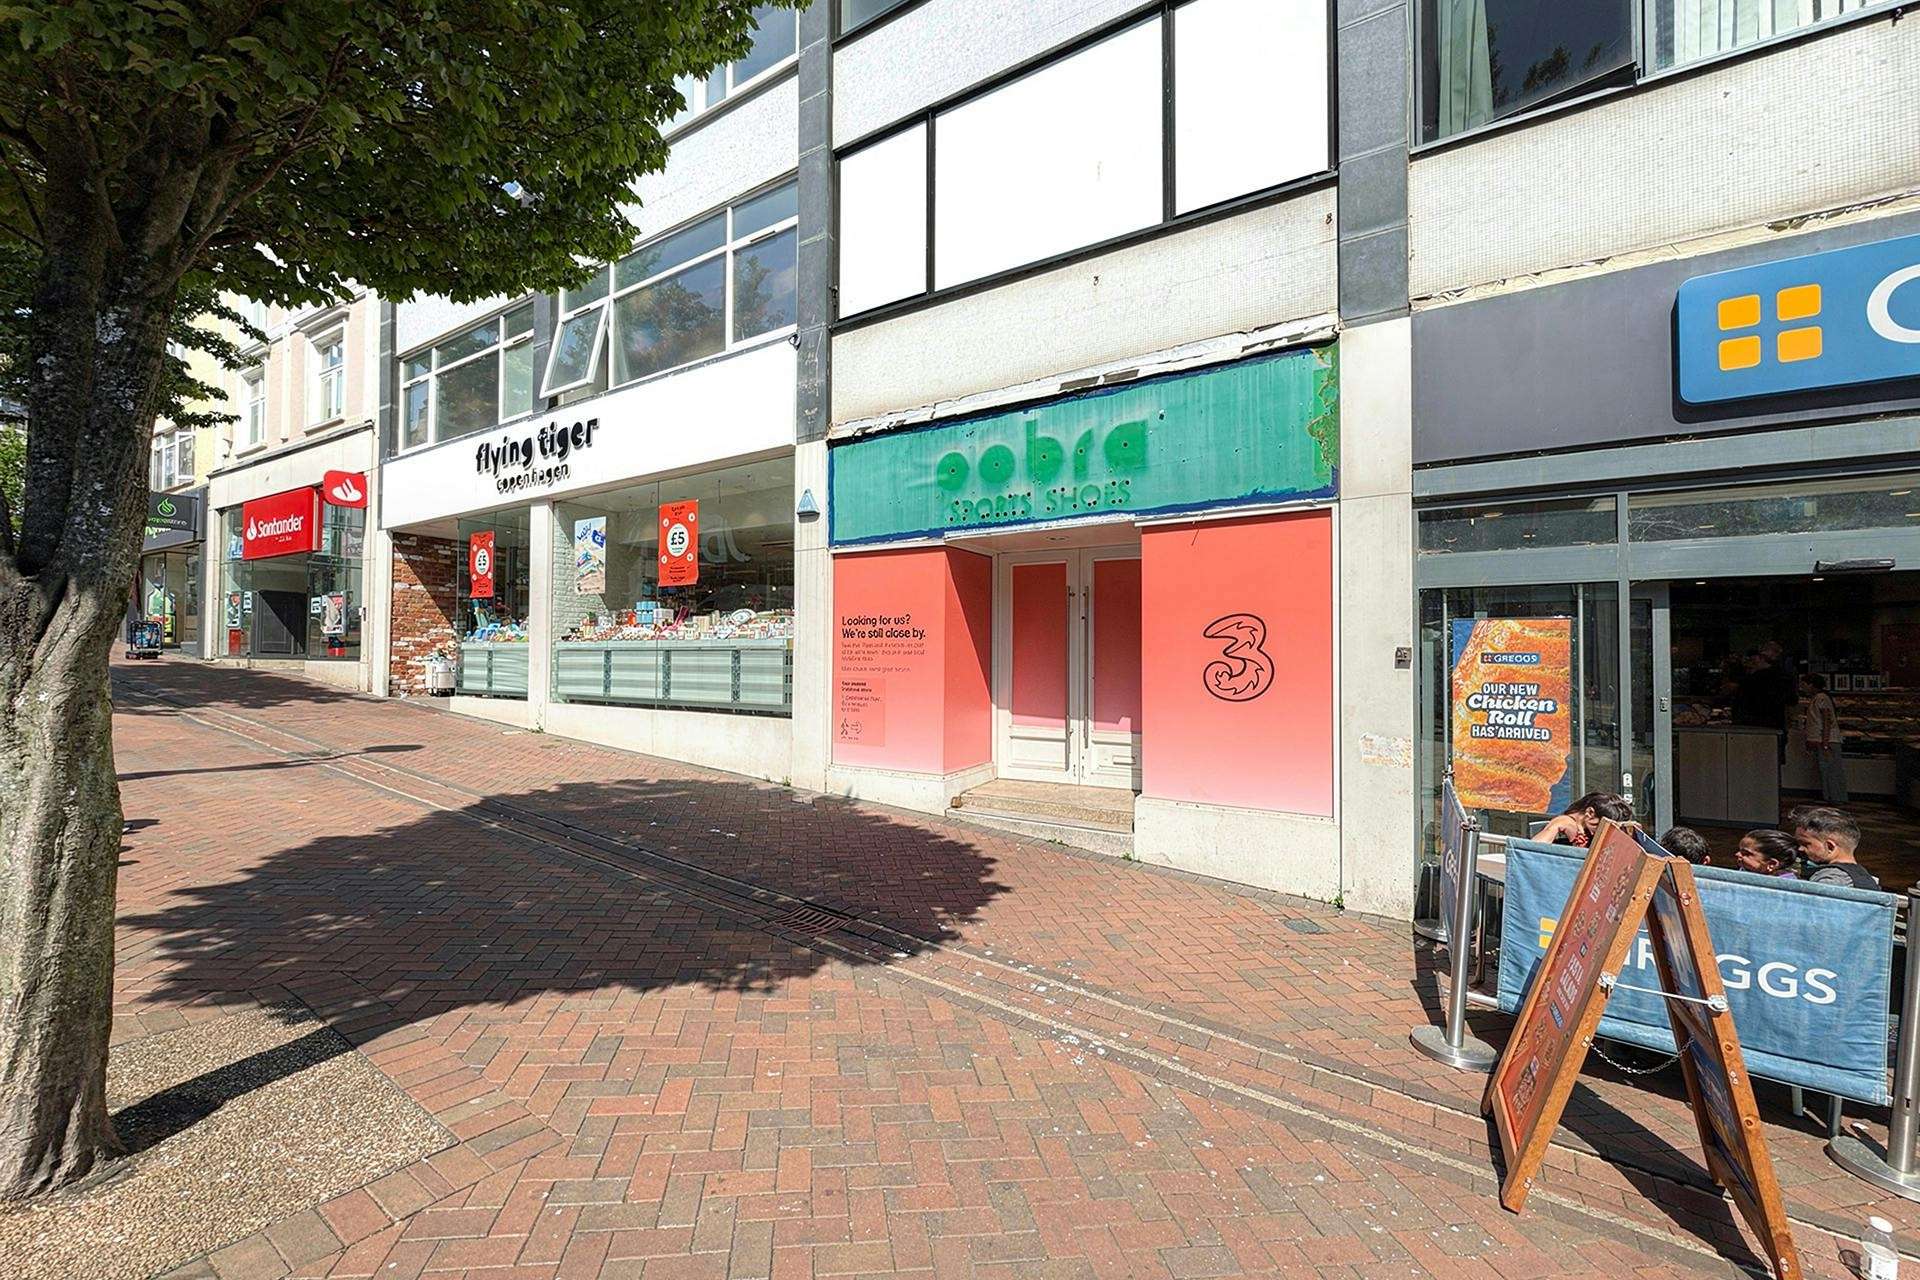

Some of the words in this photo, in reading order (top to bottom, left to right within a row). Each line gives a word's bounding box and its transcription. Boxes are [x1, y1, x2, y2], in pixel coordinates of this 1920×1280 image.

[476, 436, 534, 478] flying
[537, 418, 600, 460] tiger
[496, 463, 571, 494] copenhagen
[949, 493, 1032, 523] SPORTS
[257, 513, 304, 538] Santander
[670, 531, 685, 546] £5
[478, 554, 487, 566] £5
[842, 615, 877, 627] Looking
[879, 615, 892, 625] for
[894, 613, 911, 625] us?
[841, 628, 866, 639] We're
[868, 627, 883, 639] still
[885, 627, 911, 638] close
[912, 627, 926, 640] by.
[1493, 654, 1538, 663] GREGGS
[1482, 683, 1507, 695] OUR
[1509, 684, 1538, 696] NEW
[1468, 694, 1555, 712] Chicken
[1488, 710, 1535, 726] Roll
[1471, 725, 1496, 737] HAS
[1497, 726, 1550, 740] ARRIVED
[1622, 937, 1838, 1005] RGGS
